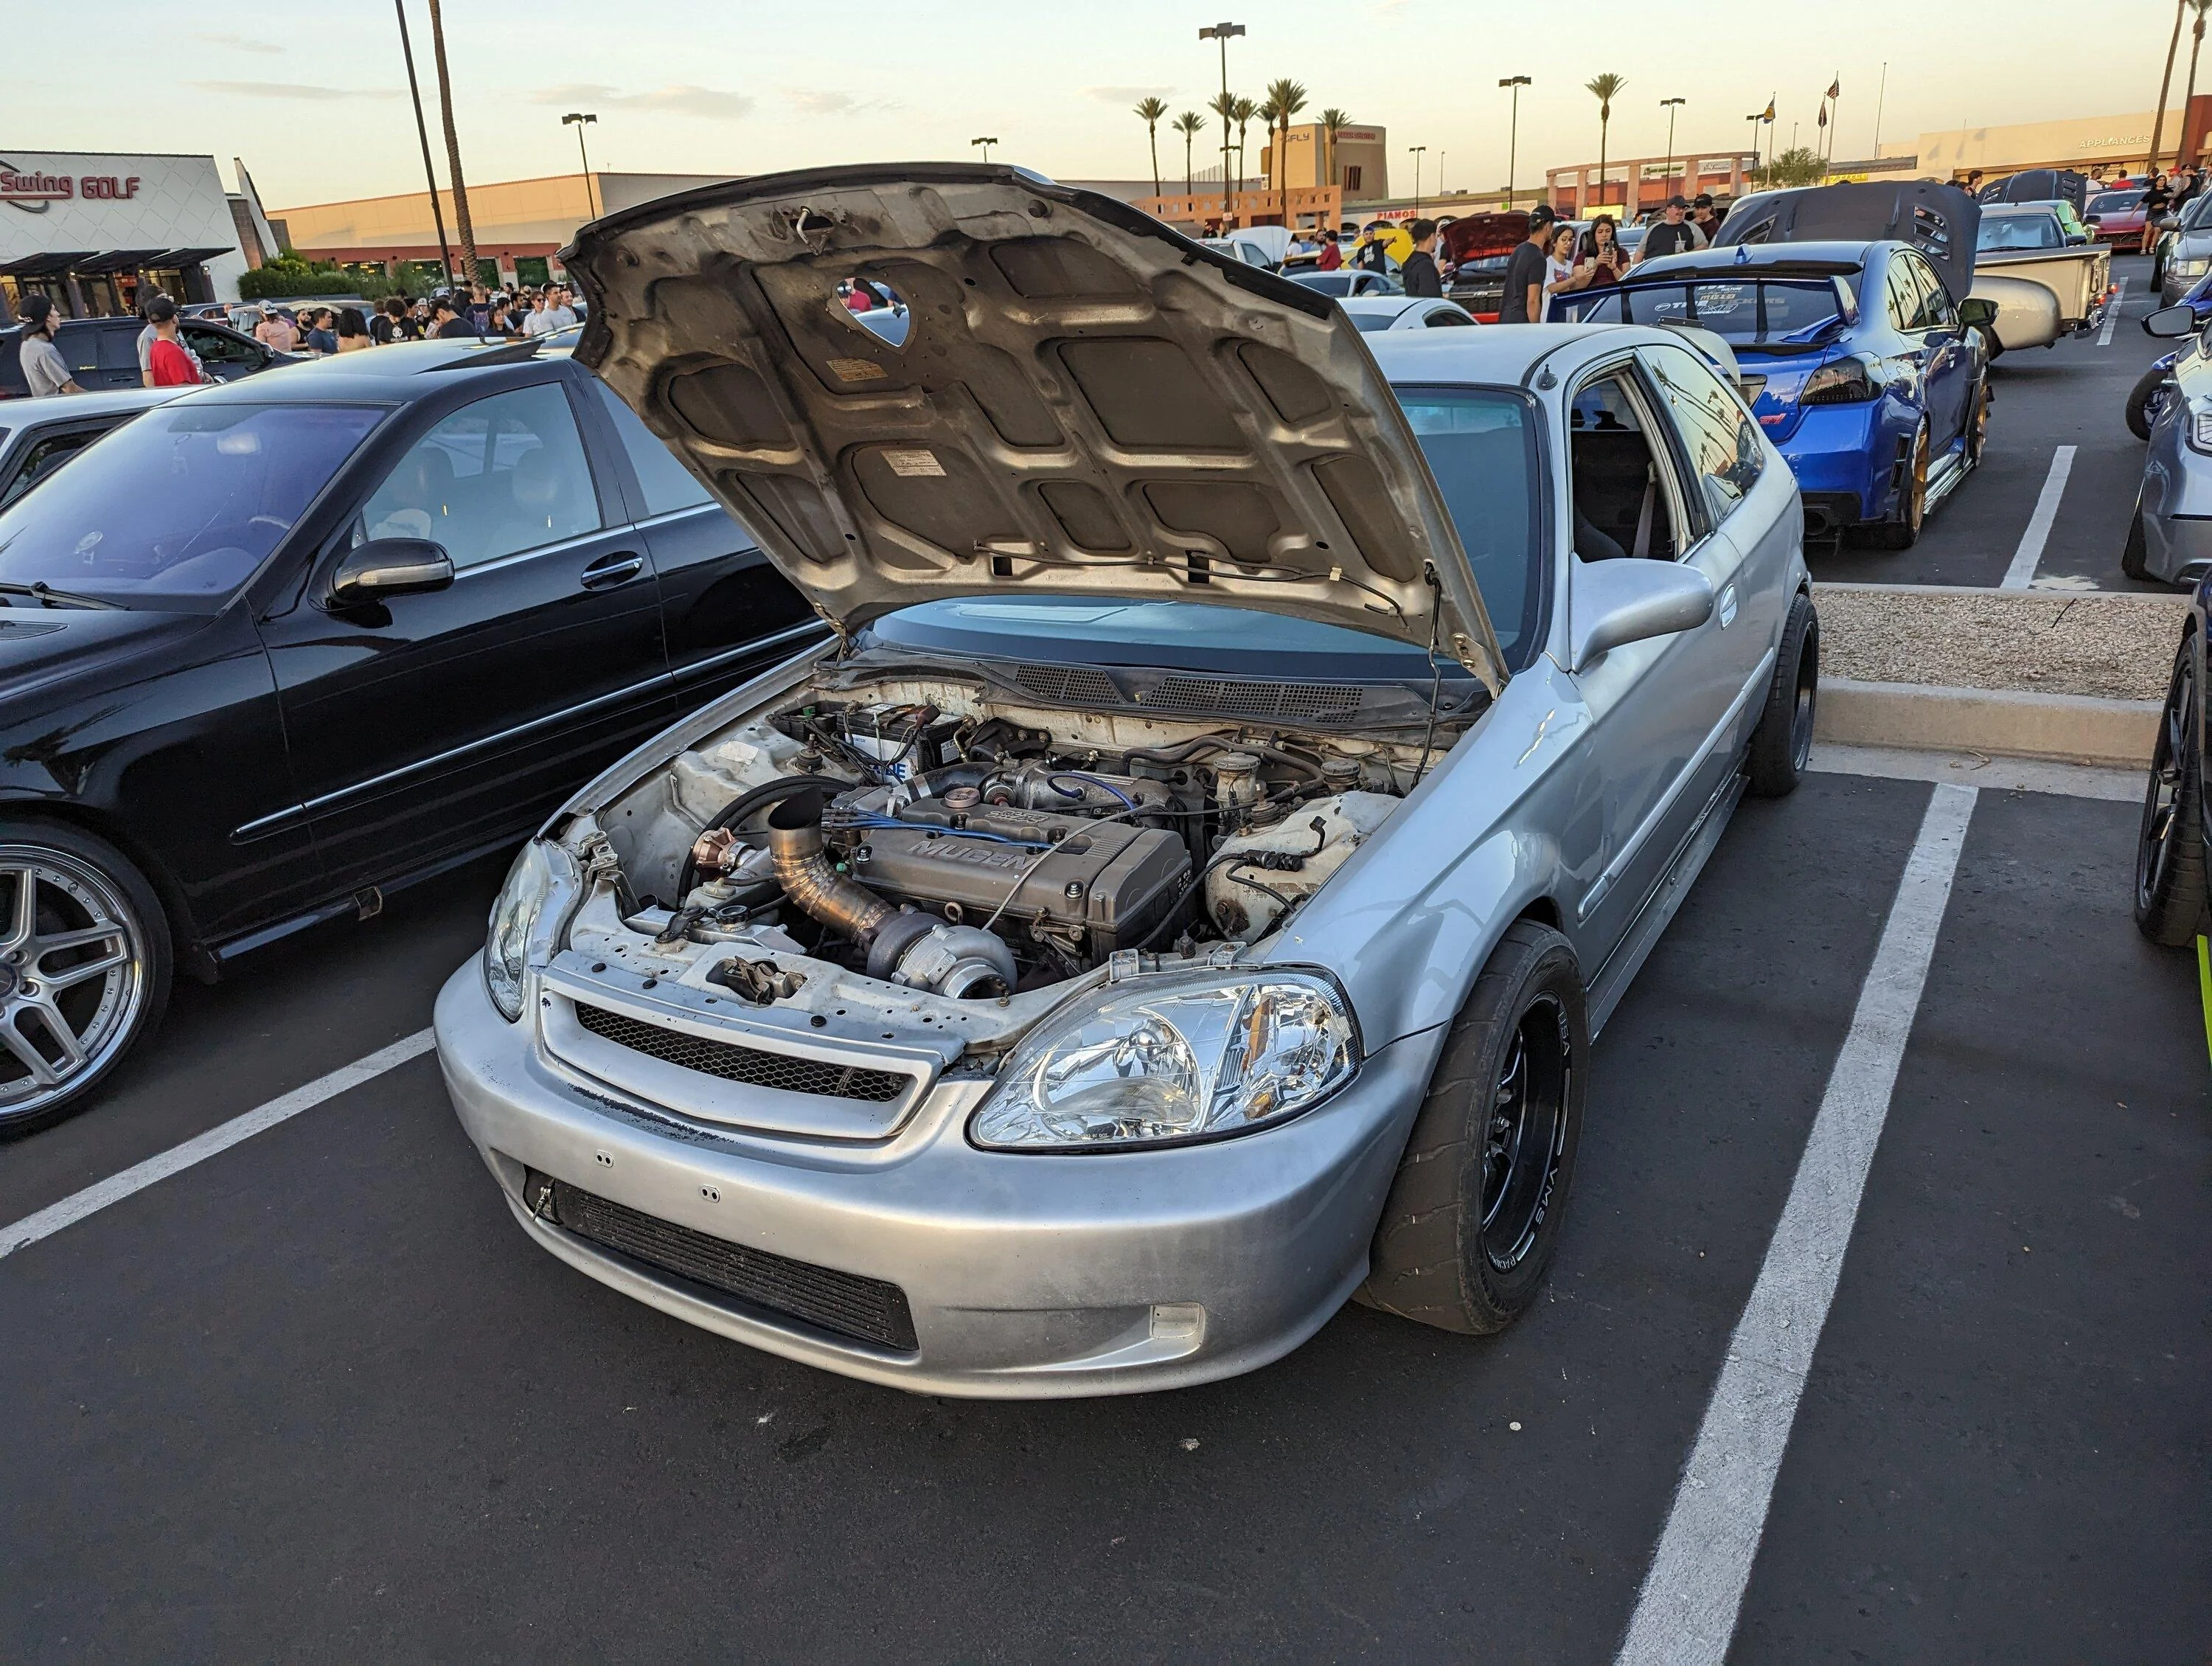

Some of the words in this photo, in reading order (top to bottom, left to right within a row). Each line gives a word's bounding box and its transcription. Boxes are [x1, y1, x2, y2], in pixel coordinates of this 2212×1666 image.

[2079, 135, 2151, 148] APPLIANCES
[0, 170, 74, 199] Swing
[81, 176, 140, 199] GOLF
[1377, 210, 1416, 220] PIANOS
[908, 841, 1040, 870] MUGEN
[1557, 1011, 1571, 1056] USA
[1535, 1167, 1559, 1225] VMS
